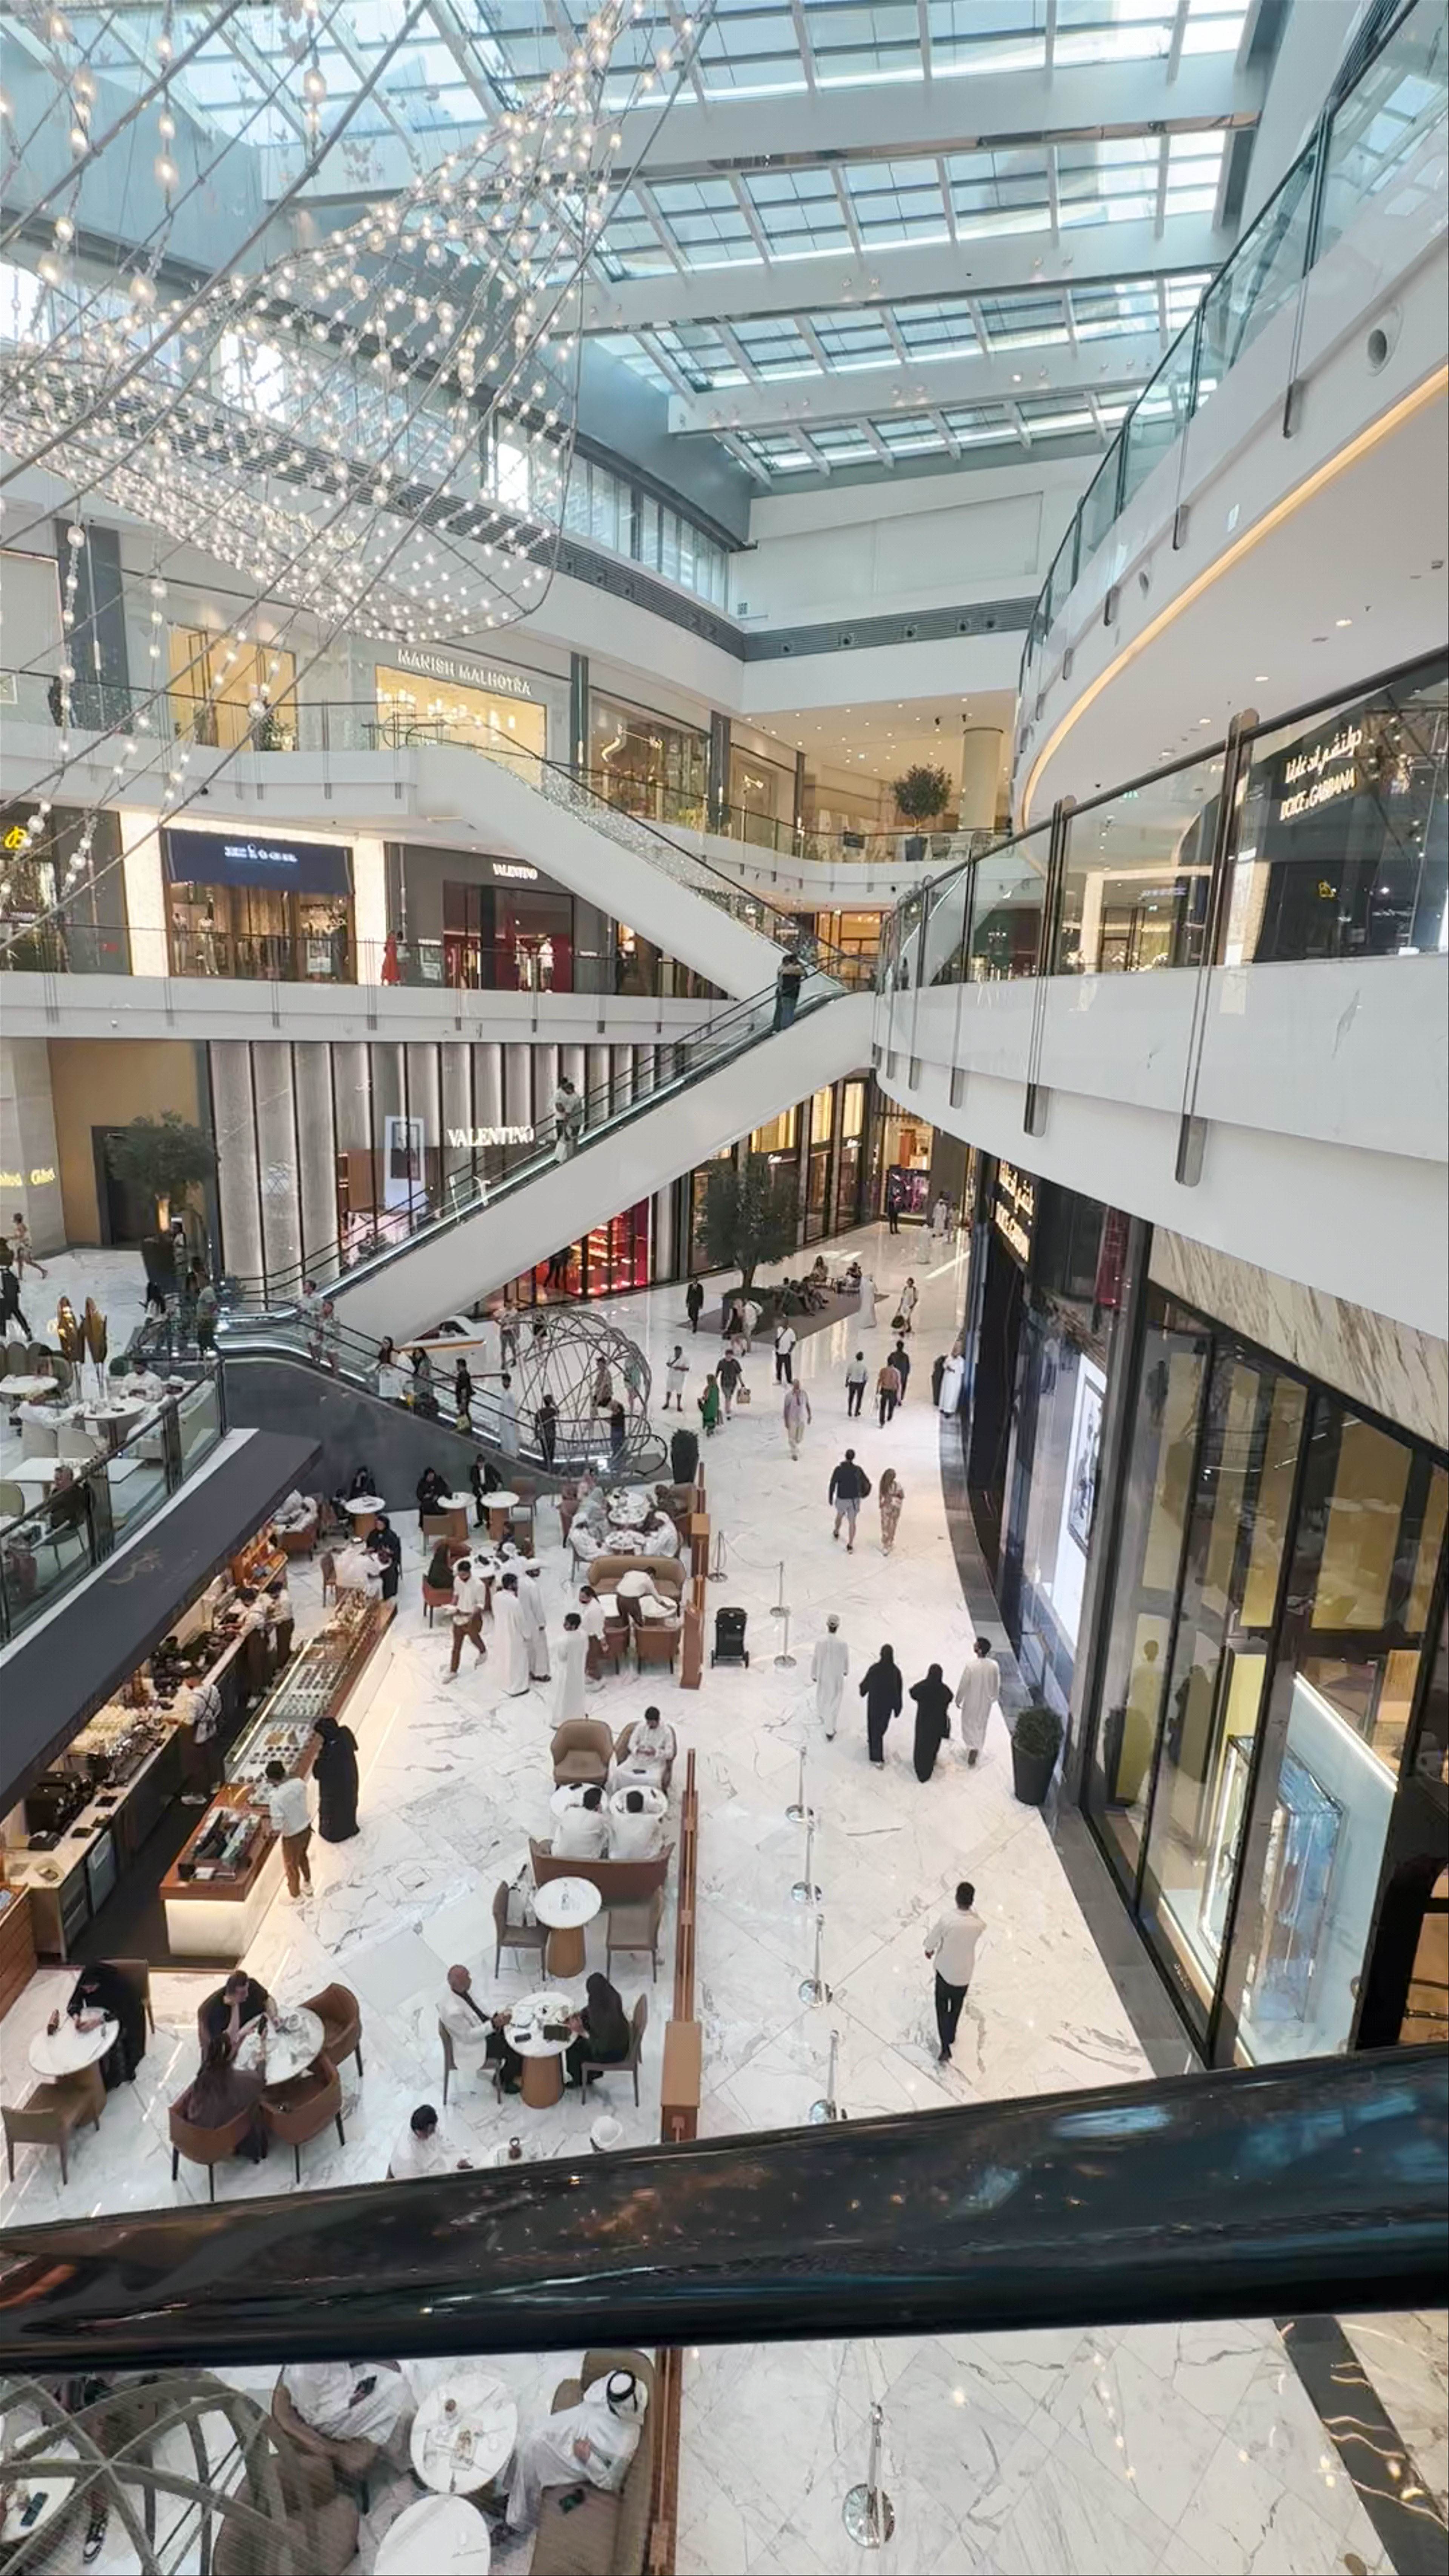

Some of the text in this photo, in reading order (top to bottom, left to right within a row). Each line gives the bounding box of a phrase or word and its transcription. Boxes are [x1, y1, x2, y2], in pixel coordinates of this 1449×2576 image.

[397, 648, 532, 696] MANISH MALHOTRA
[493, 863, 538, 880] VALENTINO
[448, 1125, 534, 1148] VALENTINO
